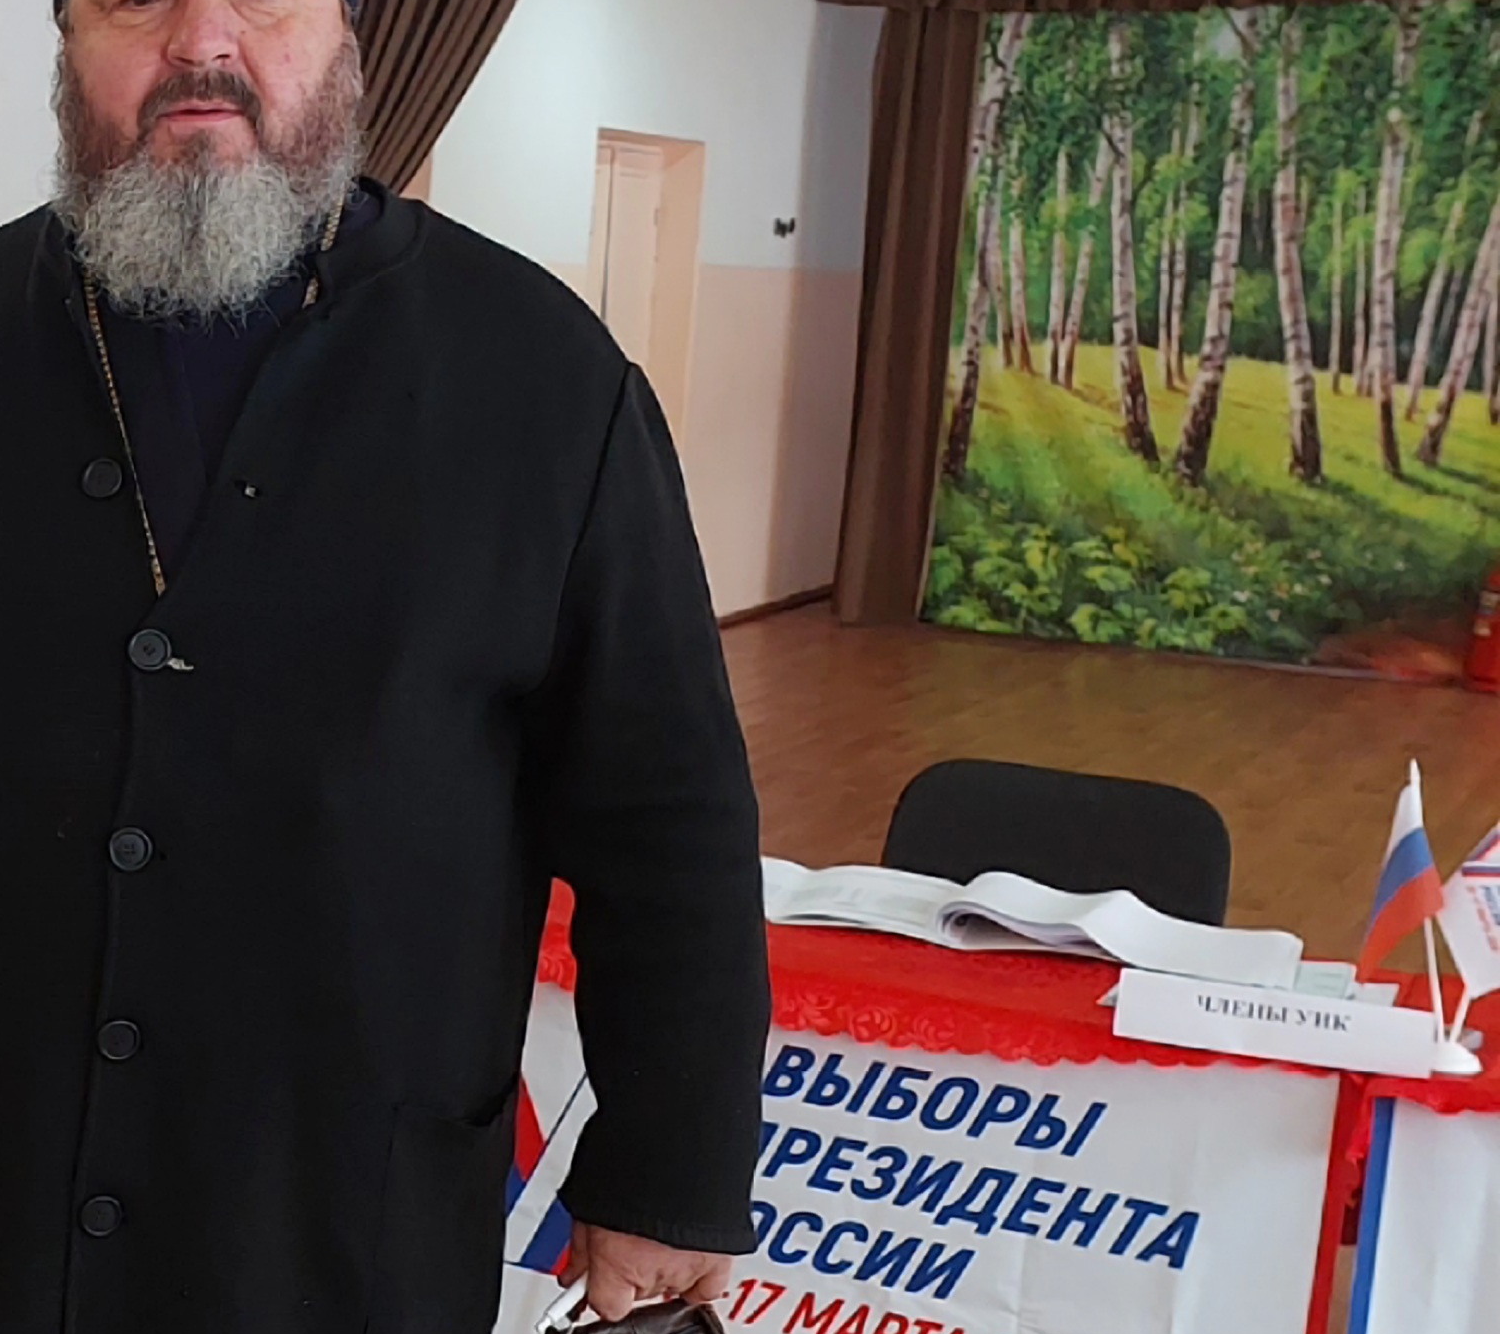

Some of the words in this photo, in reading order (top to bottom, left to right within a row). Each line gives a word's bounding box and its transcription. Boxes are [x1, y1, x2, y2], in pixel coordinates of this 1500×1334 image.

[1197, 993, 1288, 1025] ЧЛЕНЫ
[1295, 1008, 1352, 1033] УИК
[762, 1044, 1108, 1158] ВЫБОРЫ
